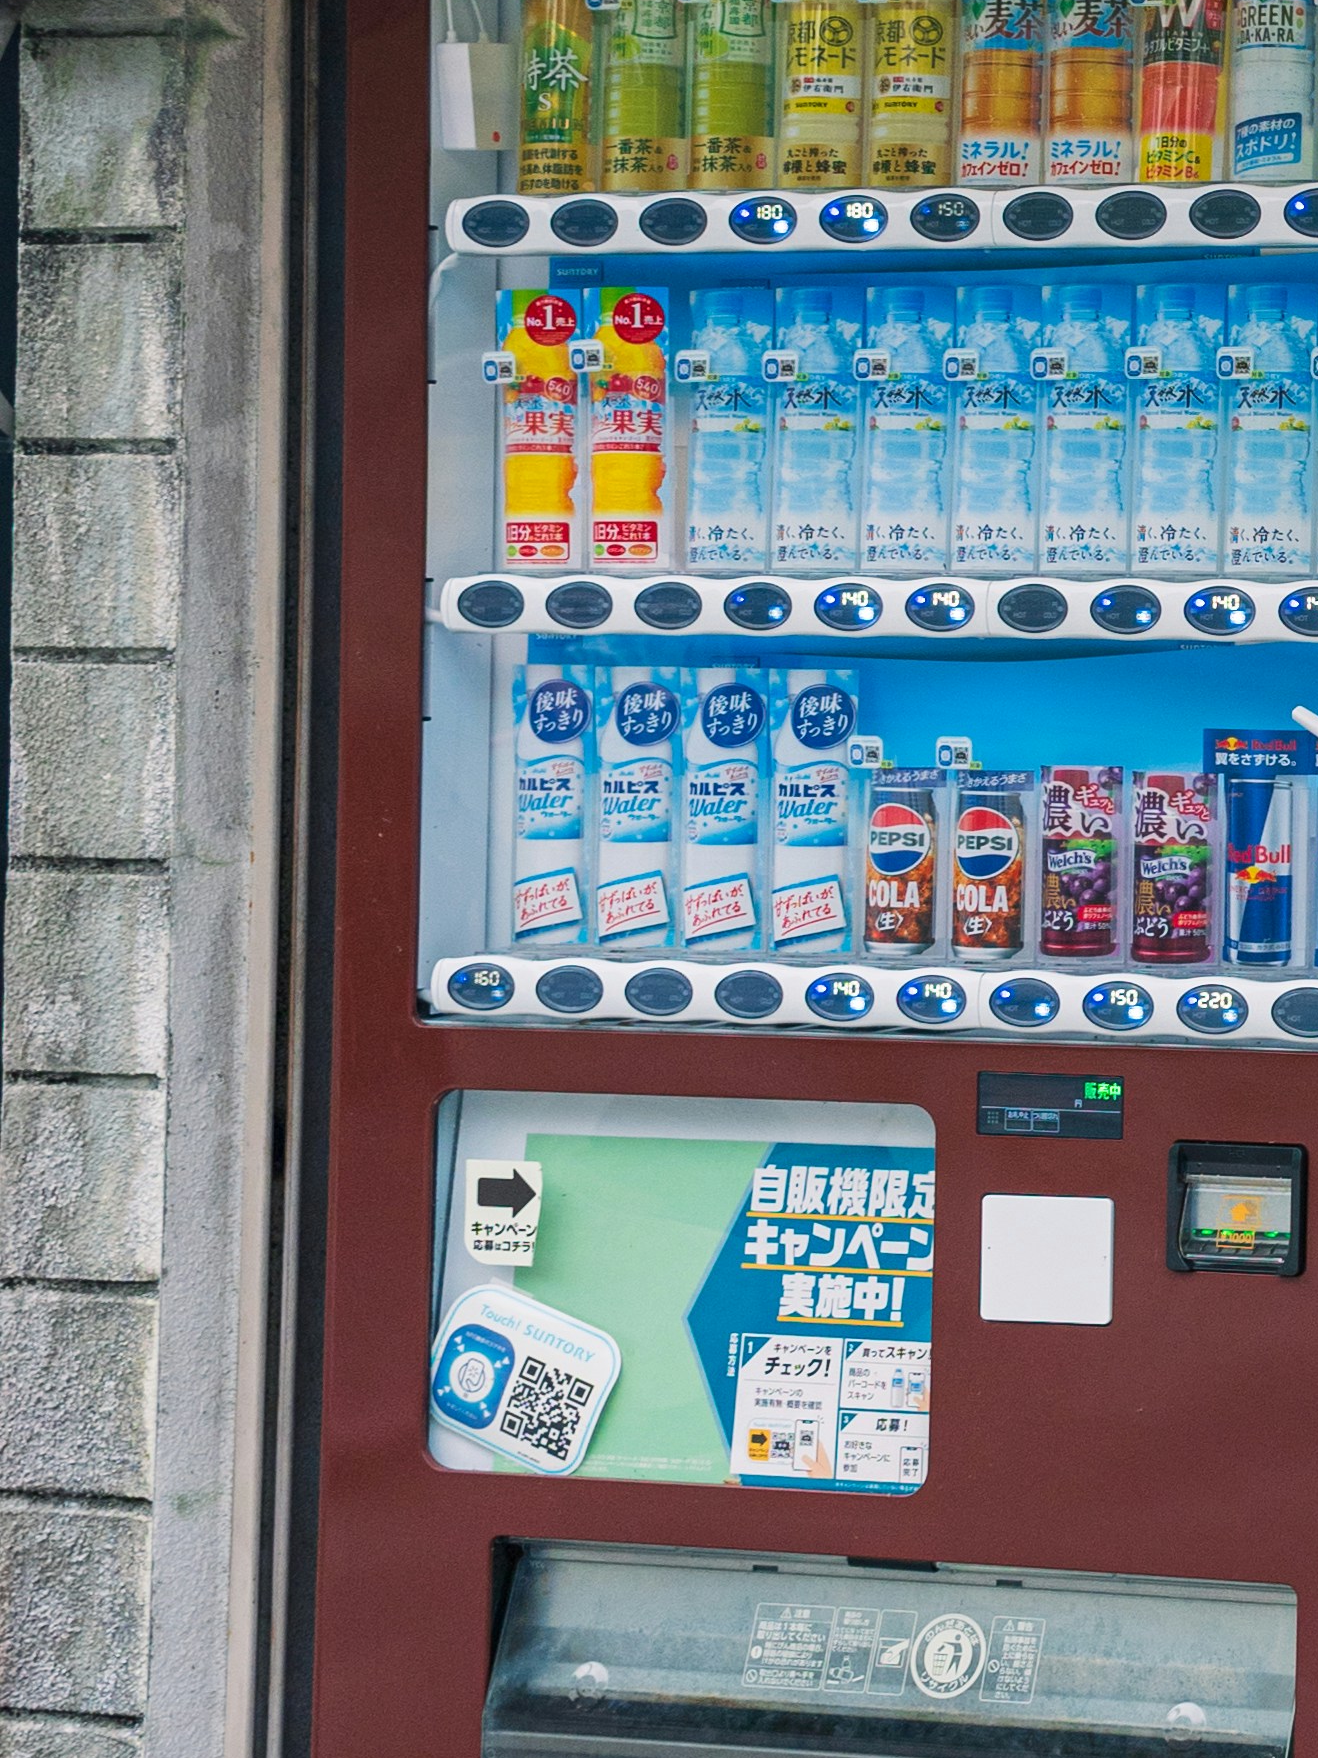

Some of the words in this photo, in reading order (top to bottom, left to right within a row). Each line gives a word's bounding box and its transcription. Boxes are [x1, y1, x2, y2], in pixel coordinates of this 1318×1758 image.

[1240, 6, 1294, 27] GREEN
[961, 142, 1029, 161] ミネラル!
[1050, 141, 1122, 161] ミネラル!
[696, 386, 752, 410] 天然水
[963, 385, 1022, 409] 天然水
[840, 589, 869, 606] 140
[535, 691, 579, 713] 後味
[706, 692, 753, 715] 後味
[798, 694, 843, 717] 後味
[532, 711, 584, 733] すっきり
[706, 714, 758, 736] すっきり
[1214, 752, 1298, 768] 翼をさずける。
[518, 777, 574, 793] カルピス
[777, 782, 838, 798] カルピス
[517, 793, 574, 812] Water
[778, 798, 839, 819] Water
[870, 831, 925, 847] PEPSI
[957, 833, 1013, 851] PEPSI
[1048, 851, 1093, 870] Welch's
[1227, 844, 1252, 864] Red
[1255, 844, 1291, 864] Bull
[1140, 857, 1189, 878] Welch's
[868, 880, 921, 909] COLA
[956, 885, 1009, 913] COLA
[1196, 992, 1233, 1010] 220
[1083, 1081, 1122, 1101] 販売中
[749, 1164, 936, 1219] 自販機限定
[470, 1221, 538, 1237] キャンペーン
[472, 1238, 536, 1253] 応募はコチラ!
[744, 1218, 934, 1271] キャンペーン
[779, 1271, 905, 1322] 実施中!
[773, 1343, 833, 1356] キャンペーンを
[764, 1356, 831, 1378] チェック!
